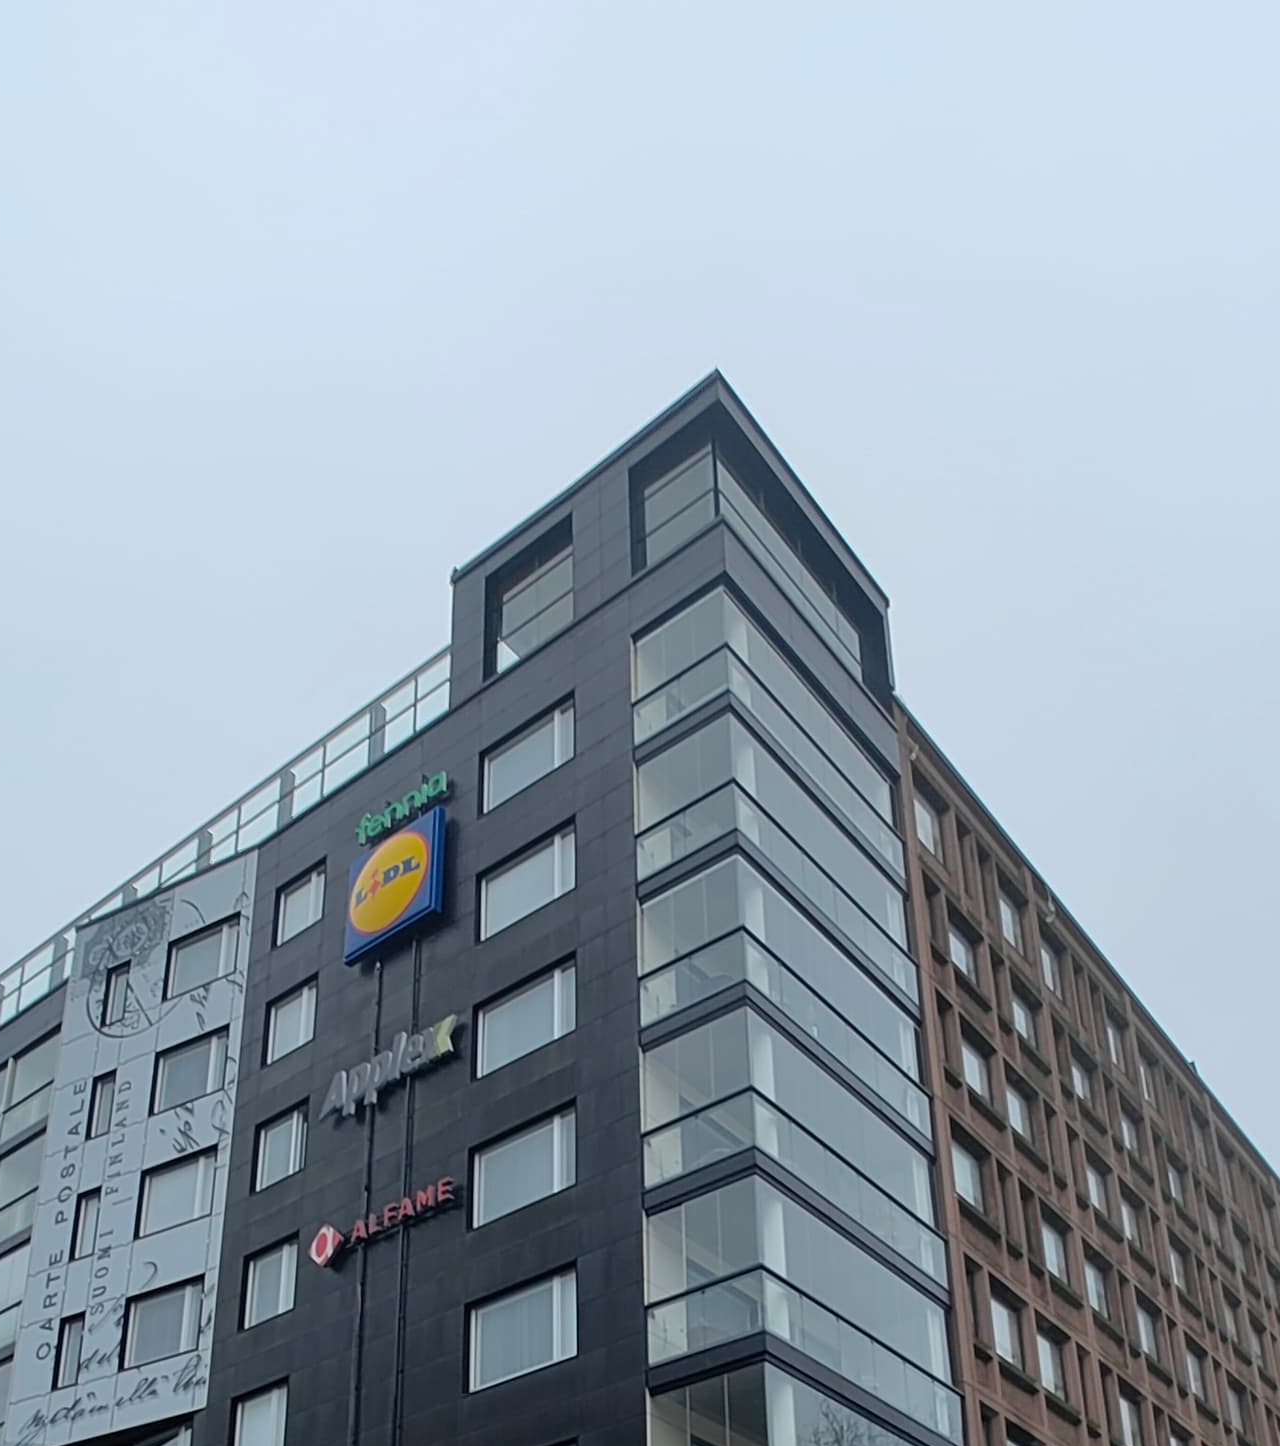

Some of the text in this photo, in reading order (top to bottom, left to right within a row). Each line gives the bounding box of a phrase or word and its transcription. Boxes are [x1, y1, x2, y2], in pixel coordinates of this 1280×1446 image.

[355, 771, 447, 846] fennia
[54, 1080, 88, 1225] POSTALE
[351, 1176, 454, 1243] ALFAME
